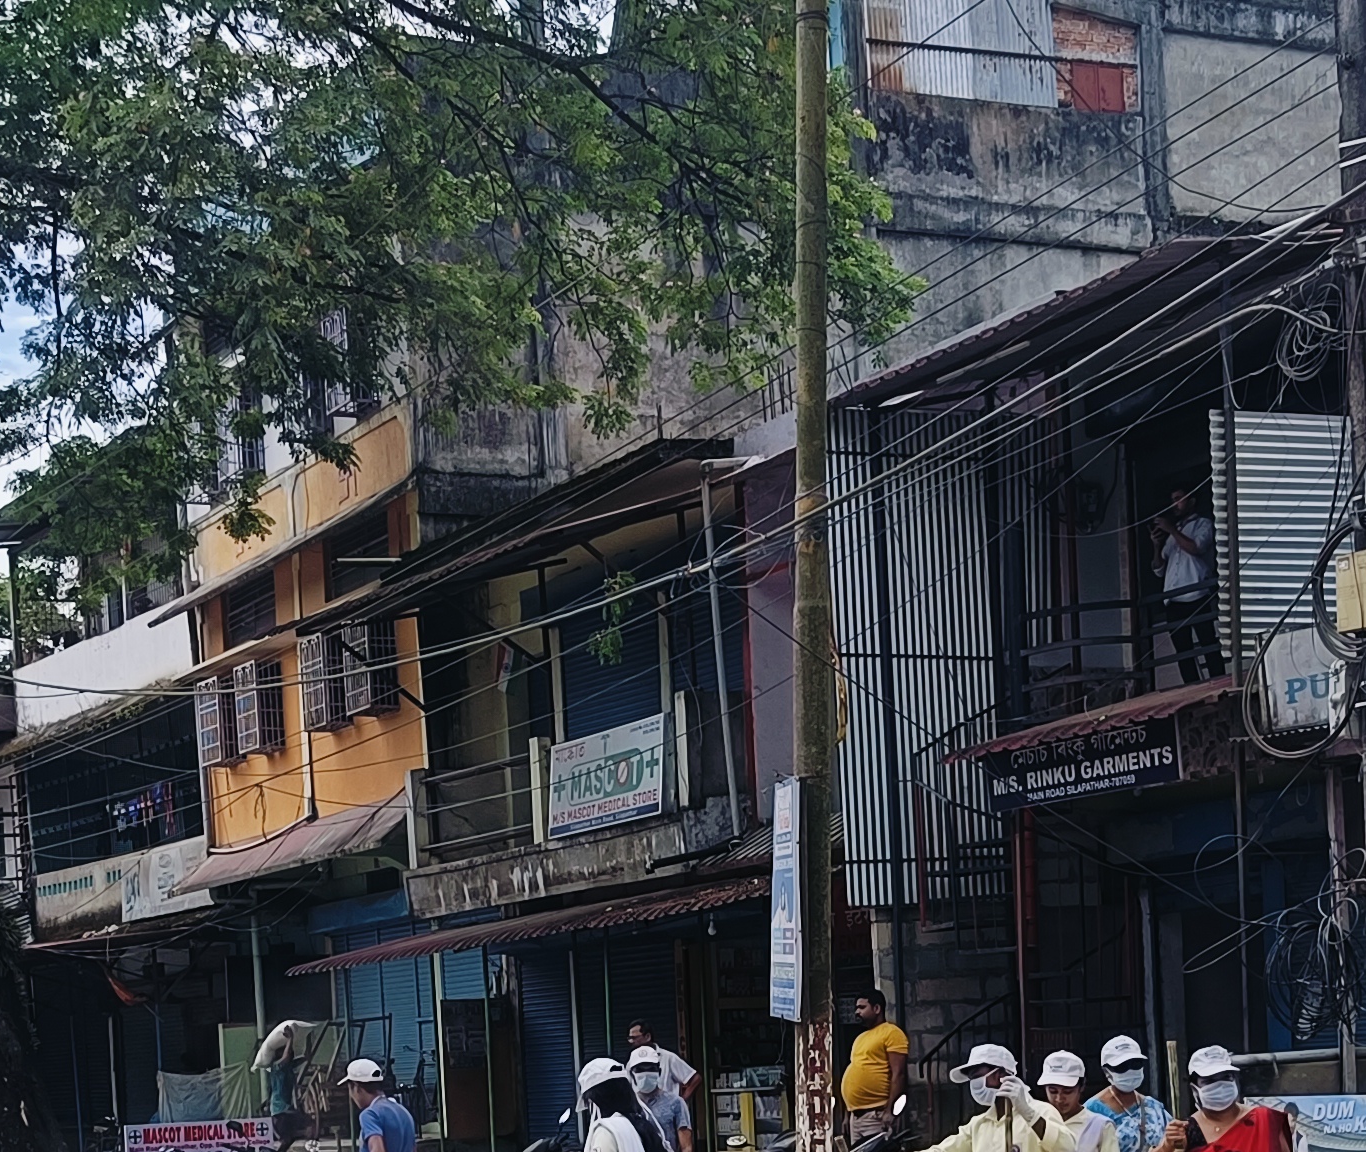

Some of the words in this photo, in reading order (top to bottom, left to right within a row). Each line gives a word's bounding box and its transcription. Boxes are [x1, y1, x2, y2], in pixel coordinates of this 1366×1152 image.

[570, 755, 641, 801] MASCOT
[1026, 763, 1076, 790] RINKU
[1080, 745, 1173, 779] GARMENTS
[566, 804, 596, 822] MASCOT
[597, 795, 631, 814] MEDICAL
[632, 788, 658, 806] STORE
[1026, 790, 1045, 802] MAIN
[1045, 786, 1065, 799] ROAD
[1312, 1100, 1355, 1121] DUM
[143, 1126, 182, 1145] MASCOT
[183, 1123, 225, 1143] MEDICAL
[1323, 1124, 1337, 1135] NA
[1338, 1122, 1353, 1134] HO
